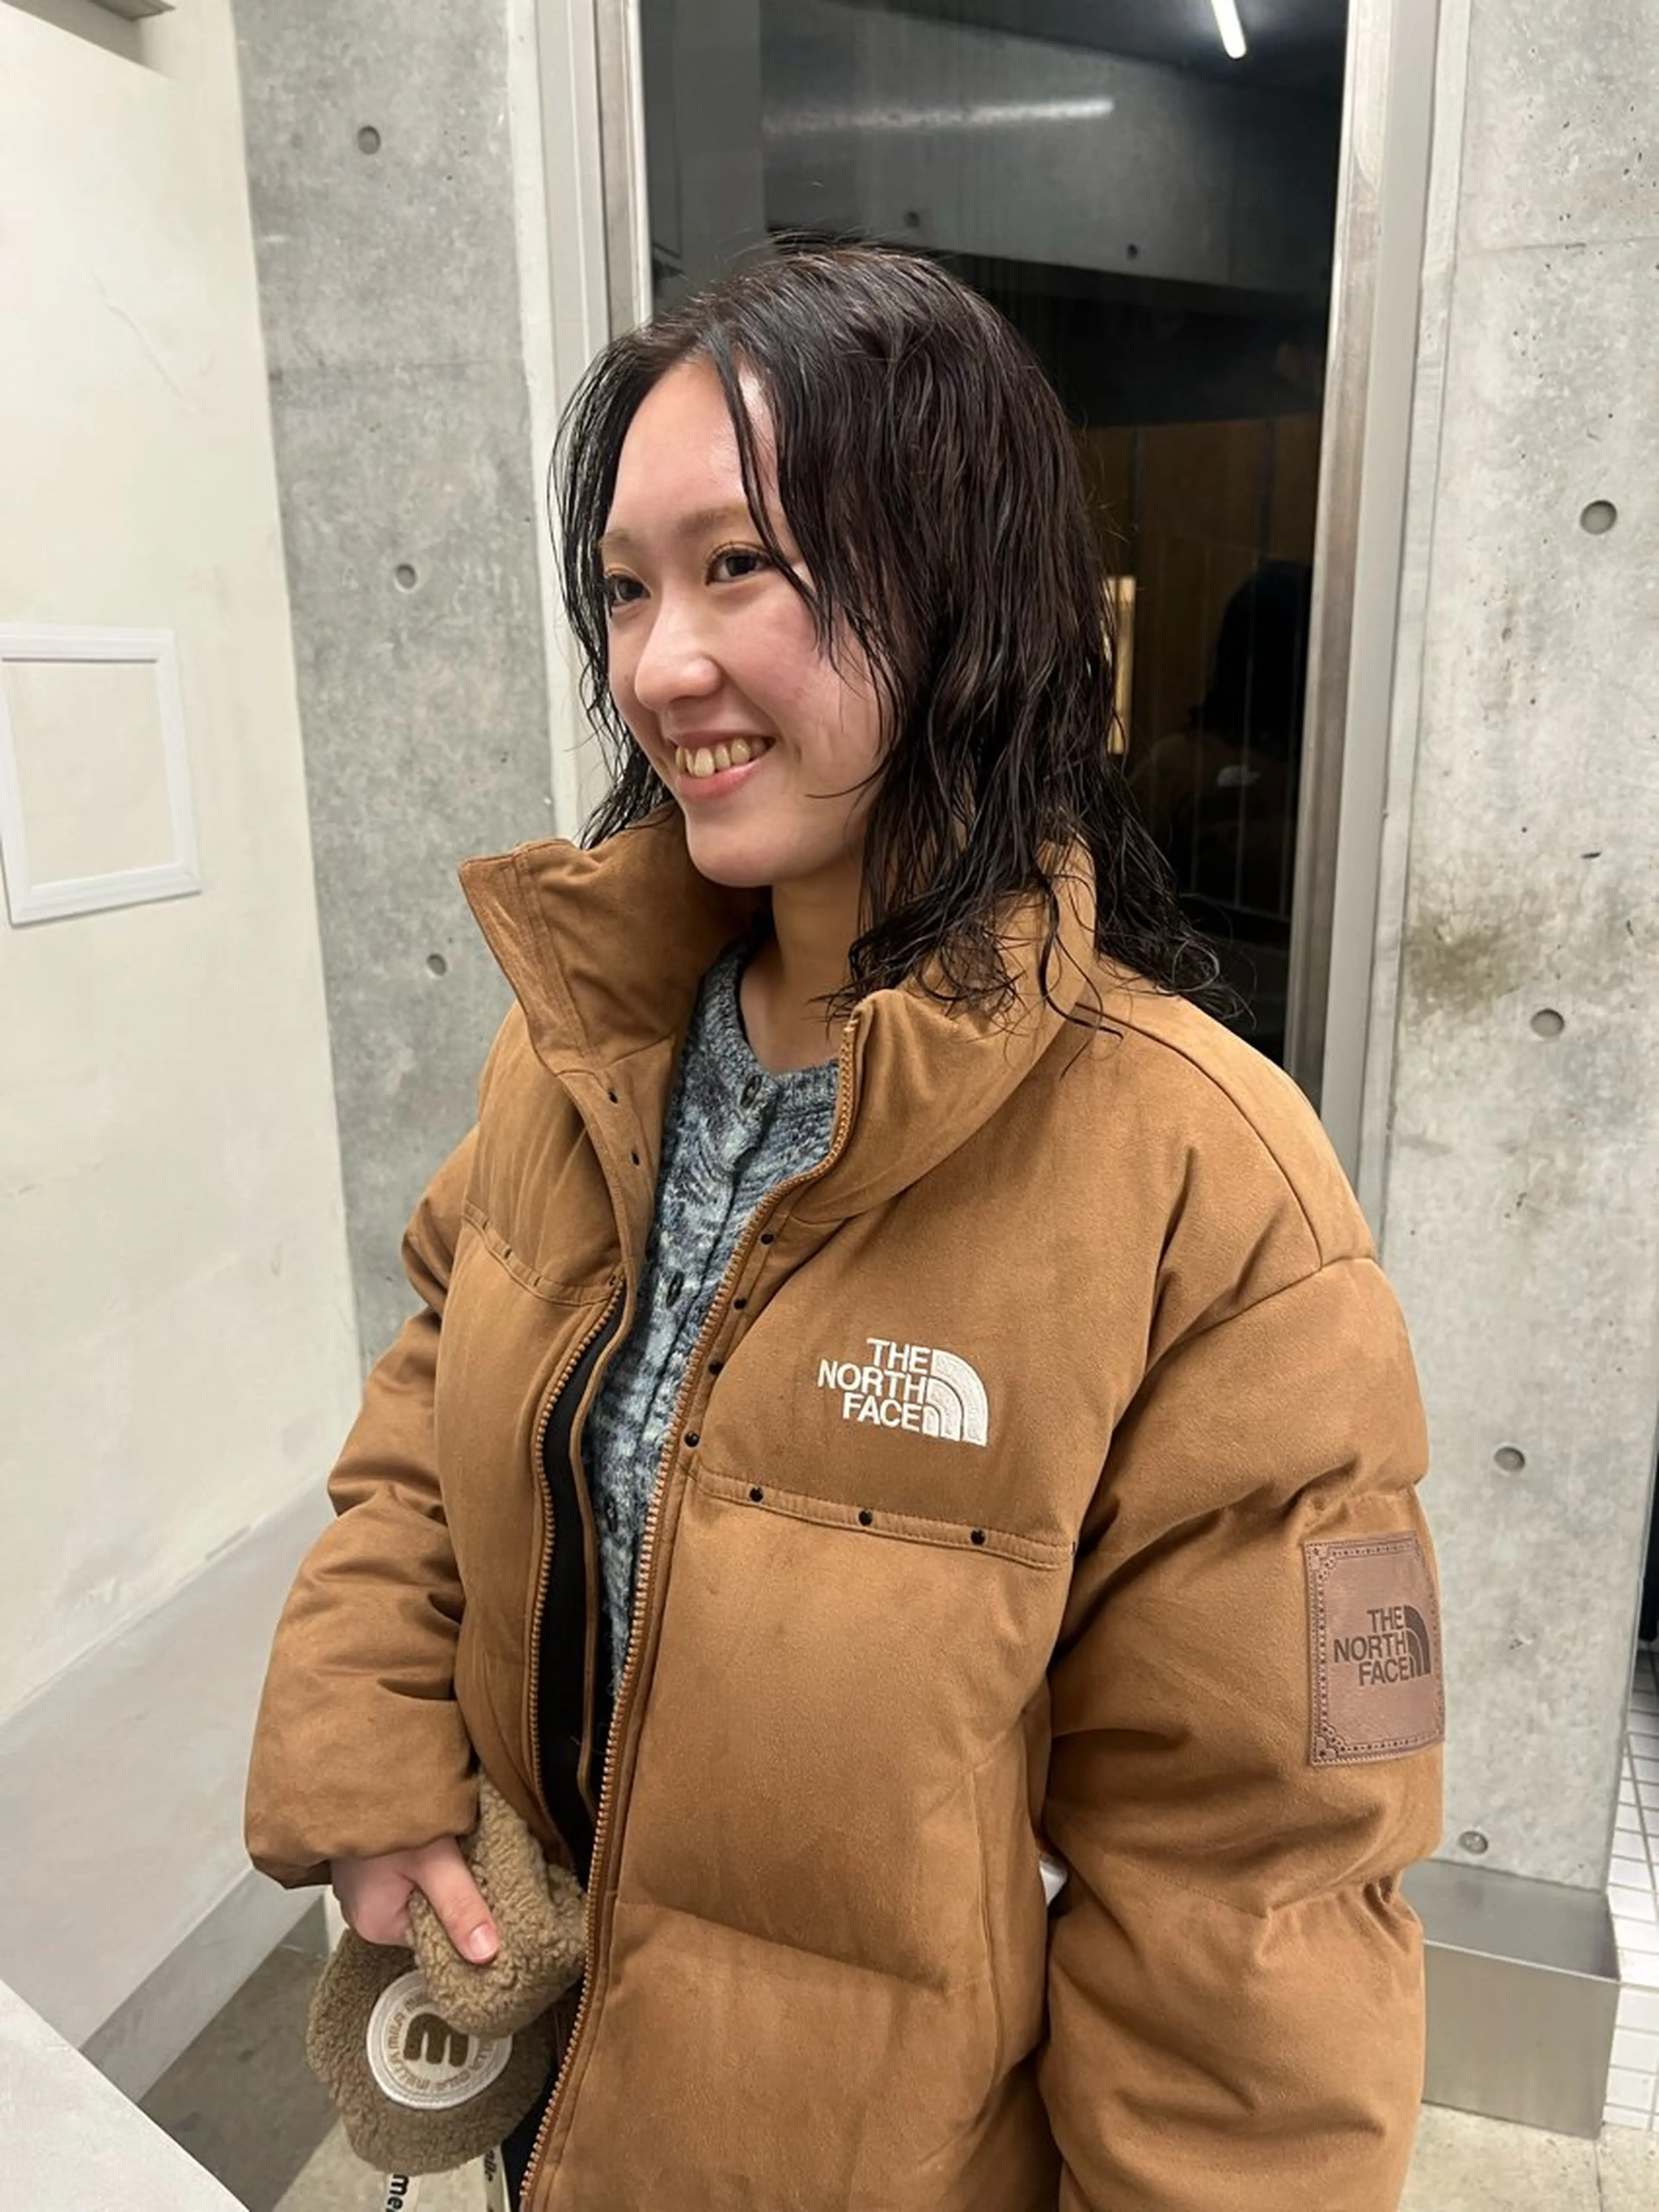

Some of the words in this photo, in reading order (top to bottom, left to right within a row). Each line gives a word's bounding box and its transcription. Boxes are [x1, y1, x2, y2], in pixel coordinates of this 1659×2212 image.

[866, 1338, 931, 1375] THE
[817, 1358, 927, 1404] NORTH
[842, 1392, 922, 1432] FACE
[1366, 1606, 1404, 1633] THE
[1333, 1632, 1406, 1663] NORTH
[1359, 1657, 1409, 1686] FACE
[386, 2174, 410, 2212] me
